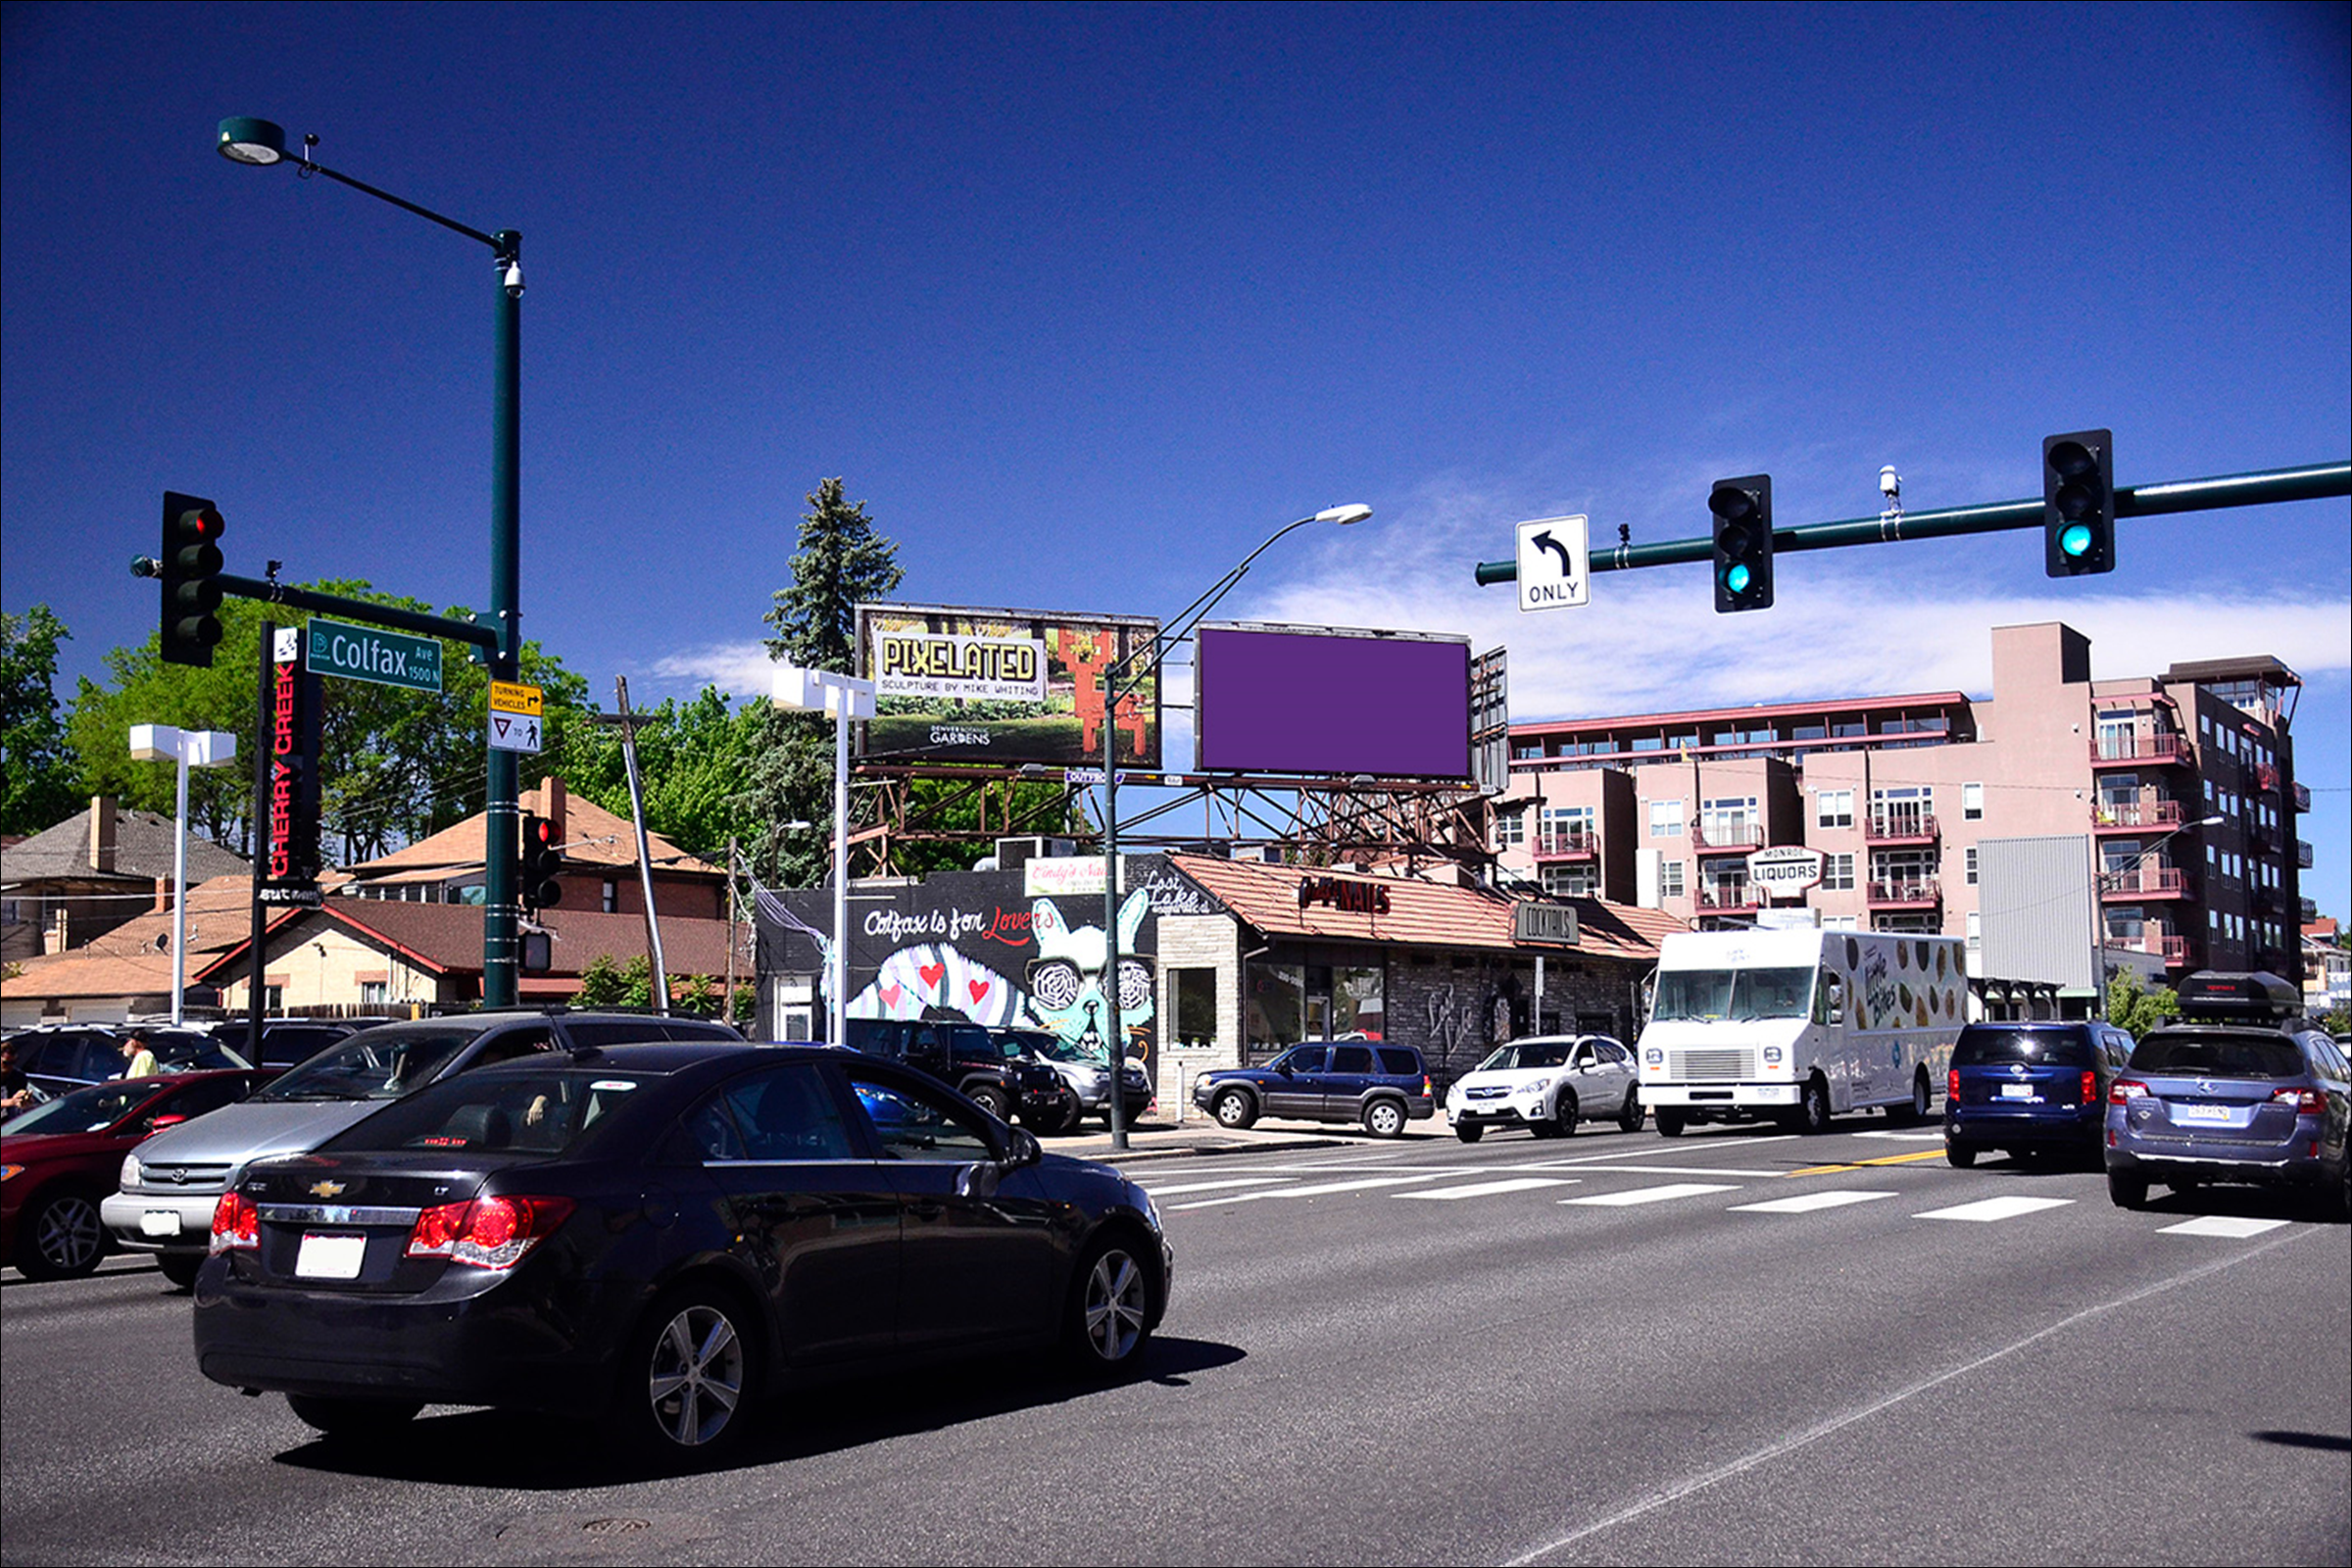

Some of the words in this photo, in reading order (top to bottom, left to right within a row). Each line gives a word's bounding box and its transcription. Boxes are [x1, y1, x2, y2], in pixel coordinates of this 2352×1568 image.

[1529, 581, 1578, 603] ONLY
[332, 634, 407, 677] Colfax
[415, 646, 433, 662] Ave
[882, 637, 1037, 683] PIXELATED
[408, 665, 431, 682] 1500
[432, 669, 440, 683] N
[494, 684, 525, 699] TURNING
[881, 679, 939, 692] SCULPTURE
[945, 683, 958, 692] BY
[963, 684, 989, 694] MIKE
[995, 686, 1039, 697] WHITING
[274, 662, 294, 756] CREEK
[494, 697, 526, 710] VEHICLES
[513, 726, 523, 738] TO
[931, 724, 959, 733] DENVER
[929, 732, 991, 746] GARDENS
[270, 760, 292, 877] CHERRY
[1753, 864, 1818, 882] LIQUORS
[1337, 880, 1391, 915] NAILS
[864, 909, 929, 943] Colfax
[930, 908, 948, 934] is
[950, 906, 986, 941] for
[982, 906, 1054, 947] Lovers
[1526, 906, 1571, 939] COCKTAILS
